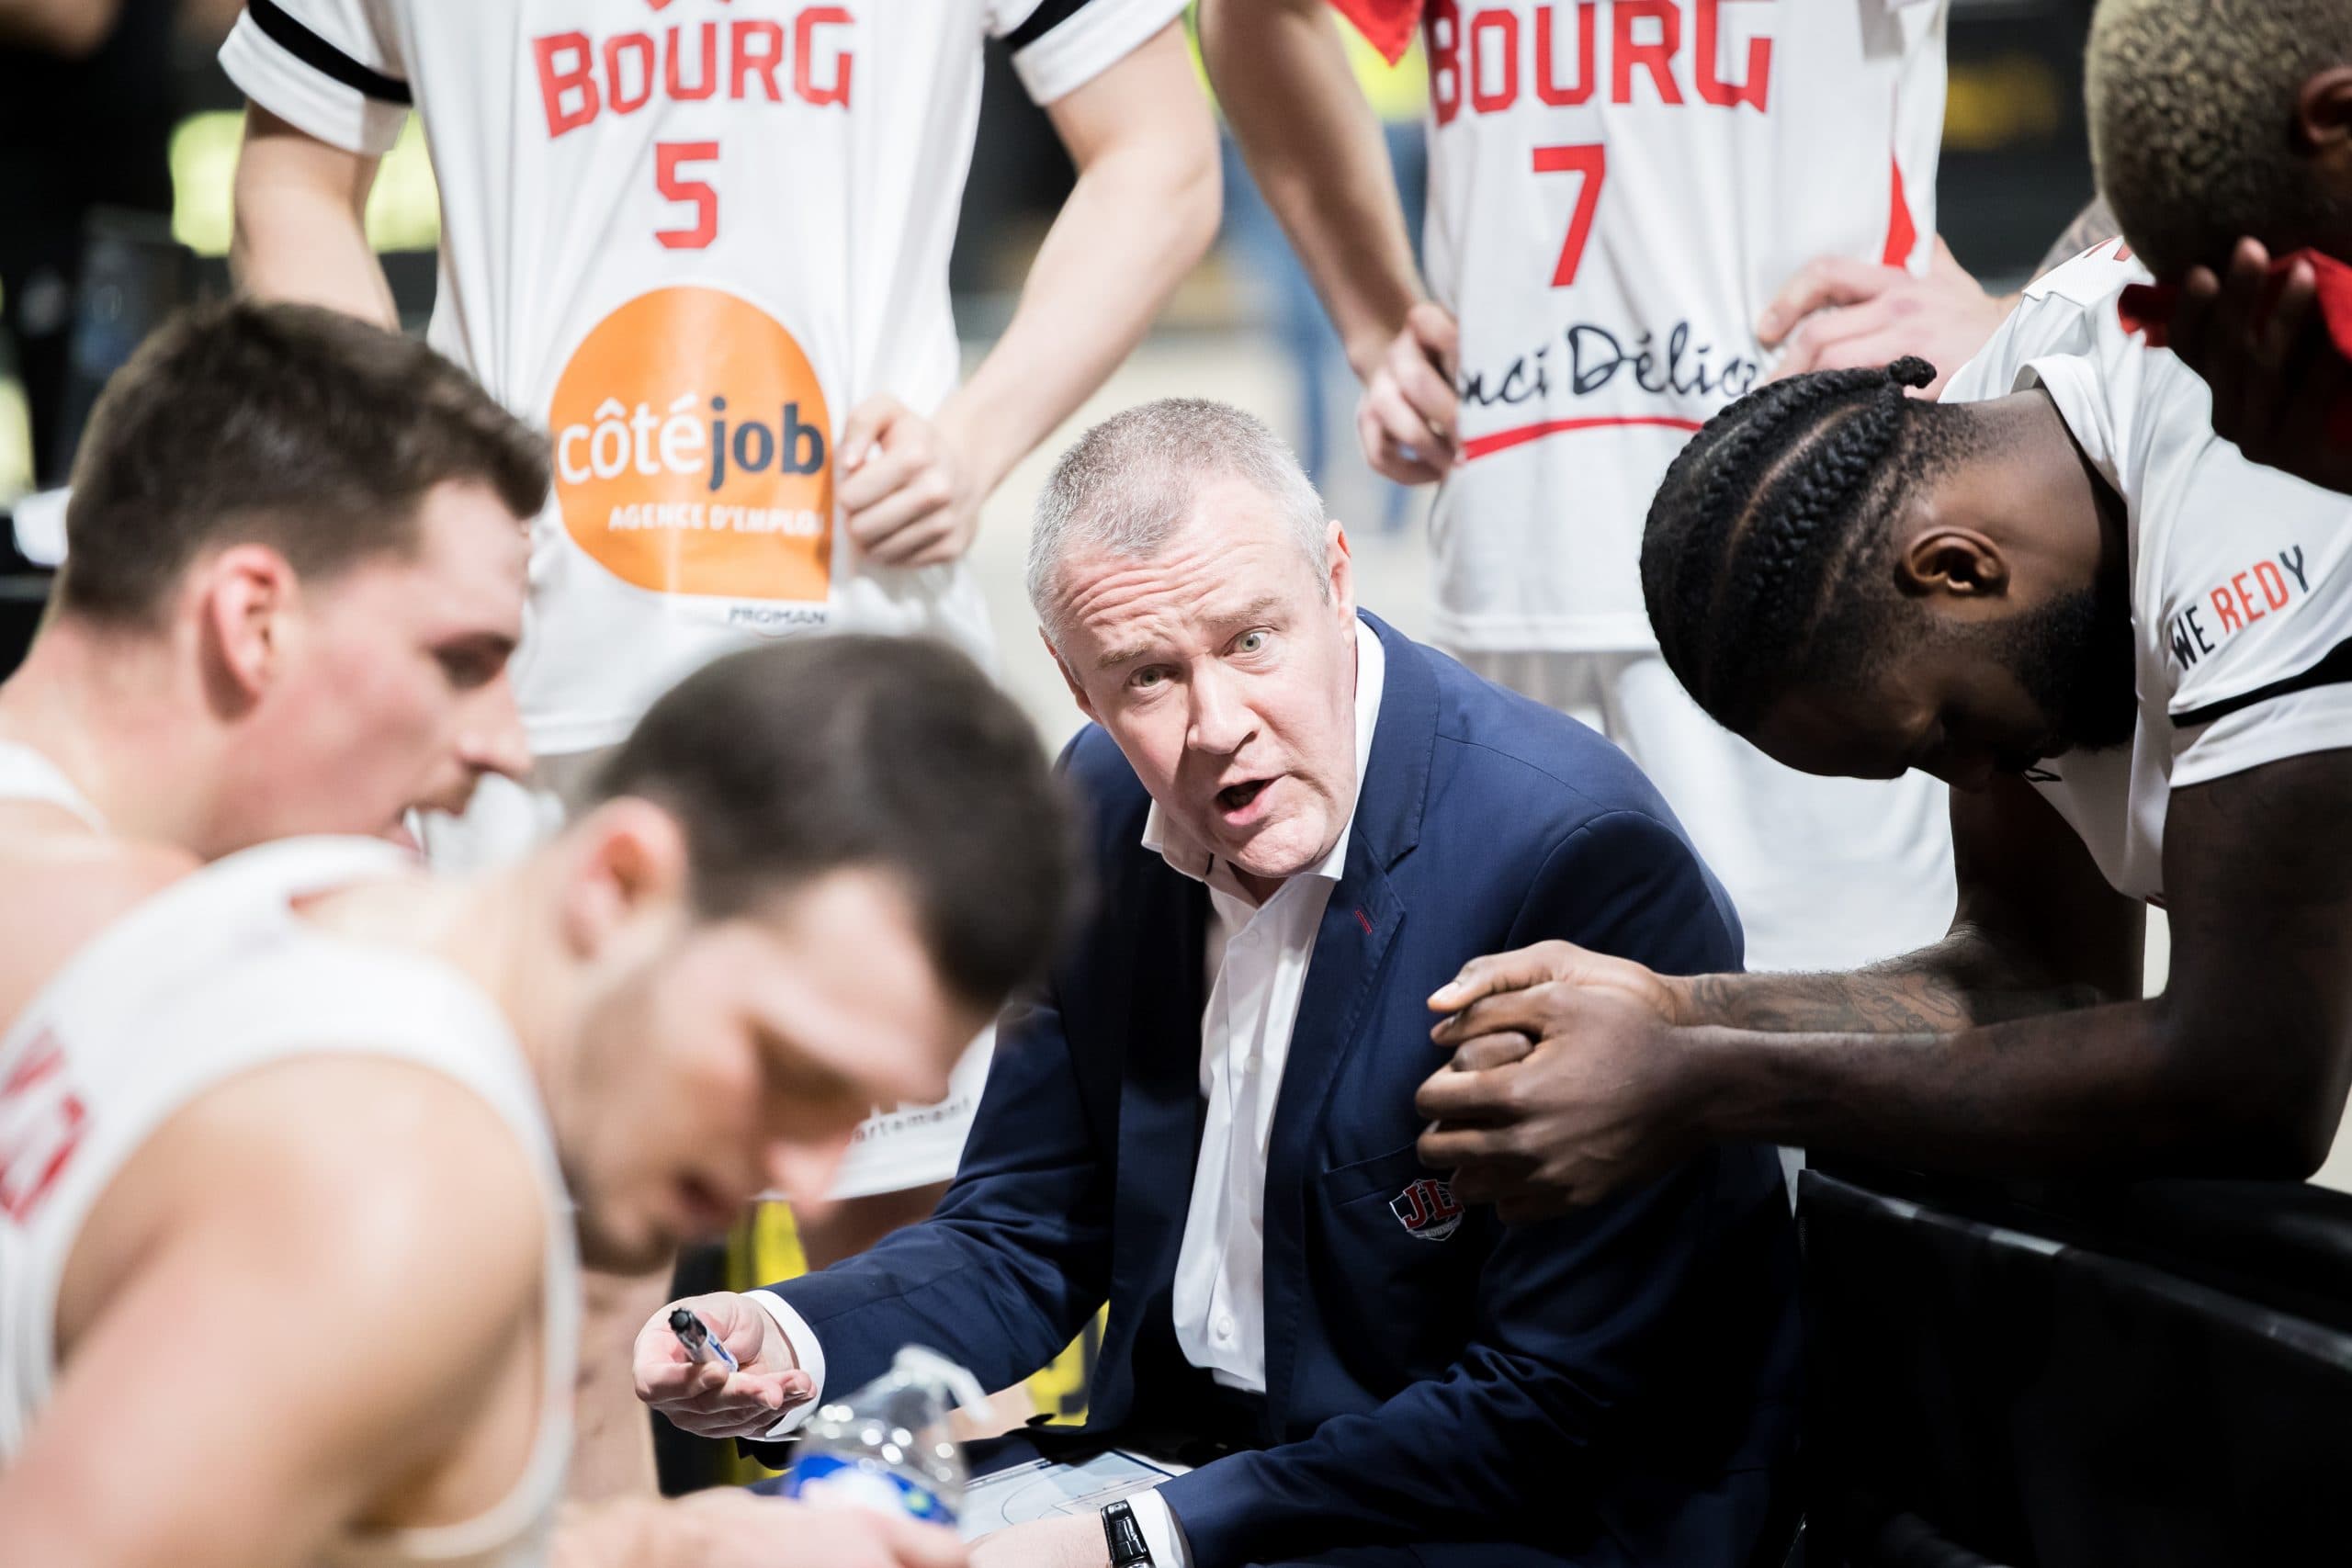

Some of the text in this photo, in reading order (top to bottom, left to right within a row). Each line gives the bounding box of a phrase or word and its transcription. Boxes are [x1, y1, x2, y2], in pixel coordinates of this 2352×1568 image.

[531, 6, 855, 140] BOURG
[1422, 0, 1772, 129] BOURG
[655, 141, 719, 249] 5
[1532, 143, 1606, 288] 7
[1457, 345, 1550, 407] nci
[608, 502, 706, 531] AGENCE
[2170, 544, 2309, 671] WE REDY
[1402, 1179, 1465, 1230] JL
